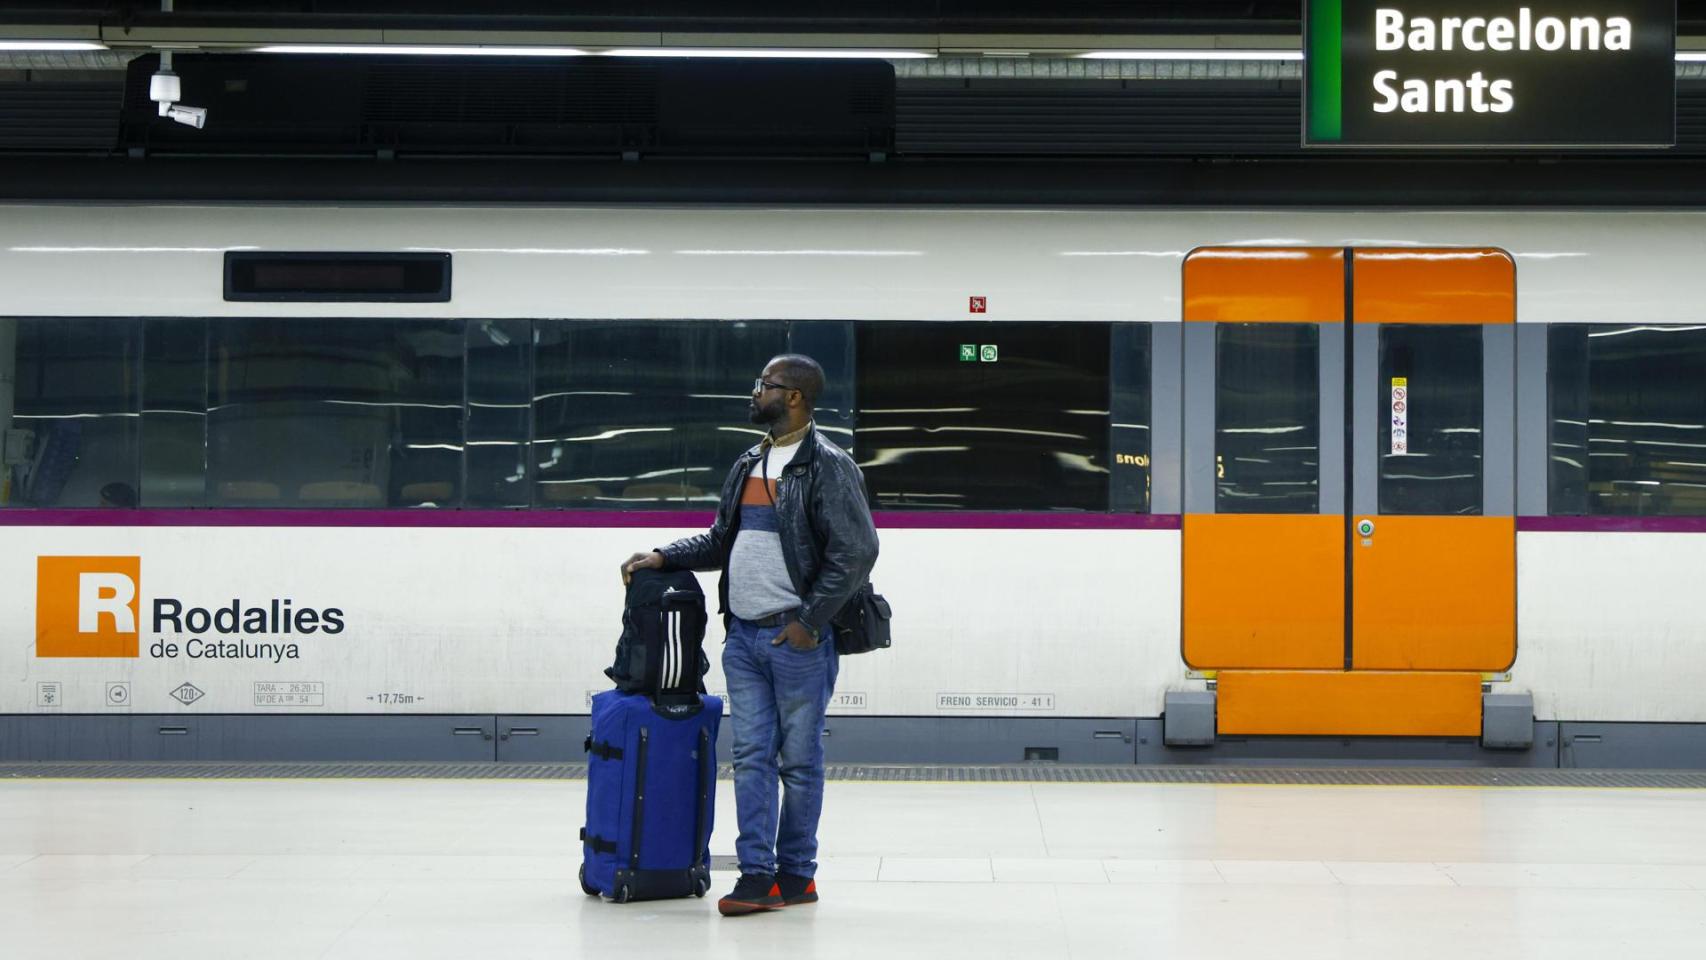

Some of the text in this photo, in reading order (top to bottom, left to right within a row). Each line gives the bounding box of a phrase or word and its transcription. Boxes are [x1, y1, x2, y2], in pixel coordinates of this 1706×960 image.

[1375, 8, 1632, 51] Barcelona
[1372, 69, 1514, 113] Sants
[79, 572, 136, 633] R
[152, 598, 345, 635] Rodalies
[150, 638, 300, 664] de Catalunya
[180, 688, 194, 700] 120
[256, 684, 276, 692] TARA
[940, 696, 971, 706] FRENO
[976, 696, 1018, 706] SERVICIO
[1031, 697, 1041, 706] 41
